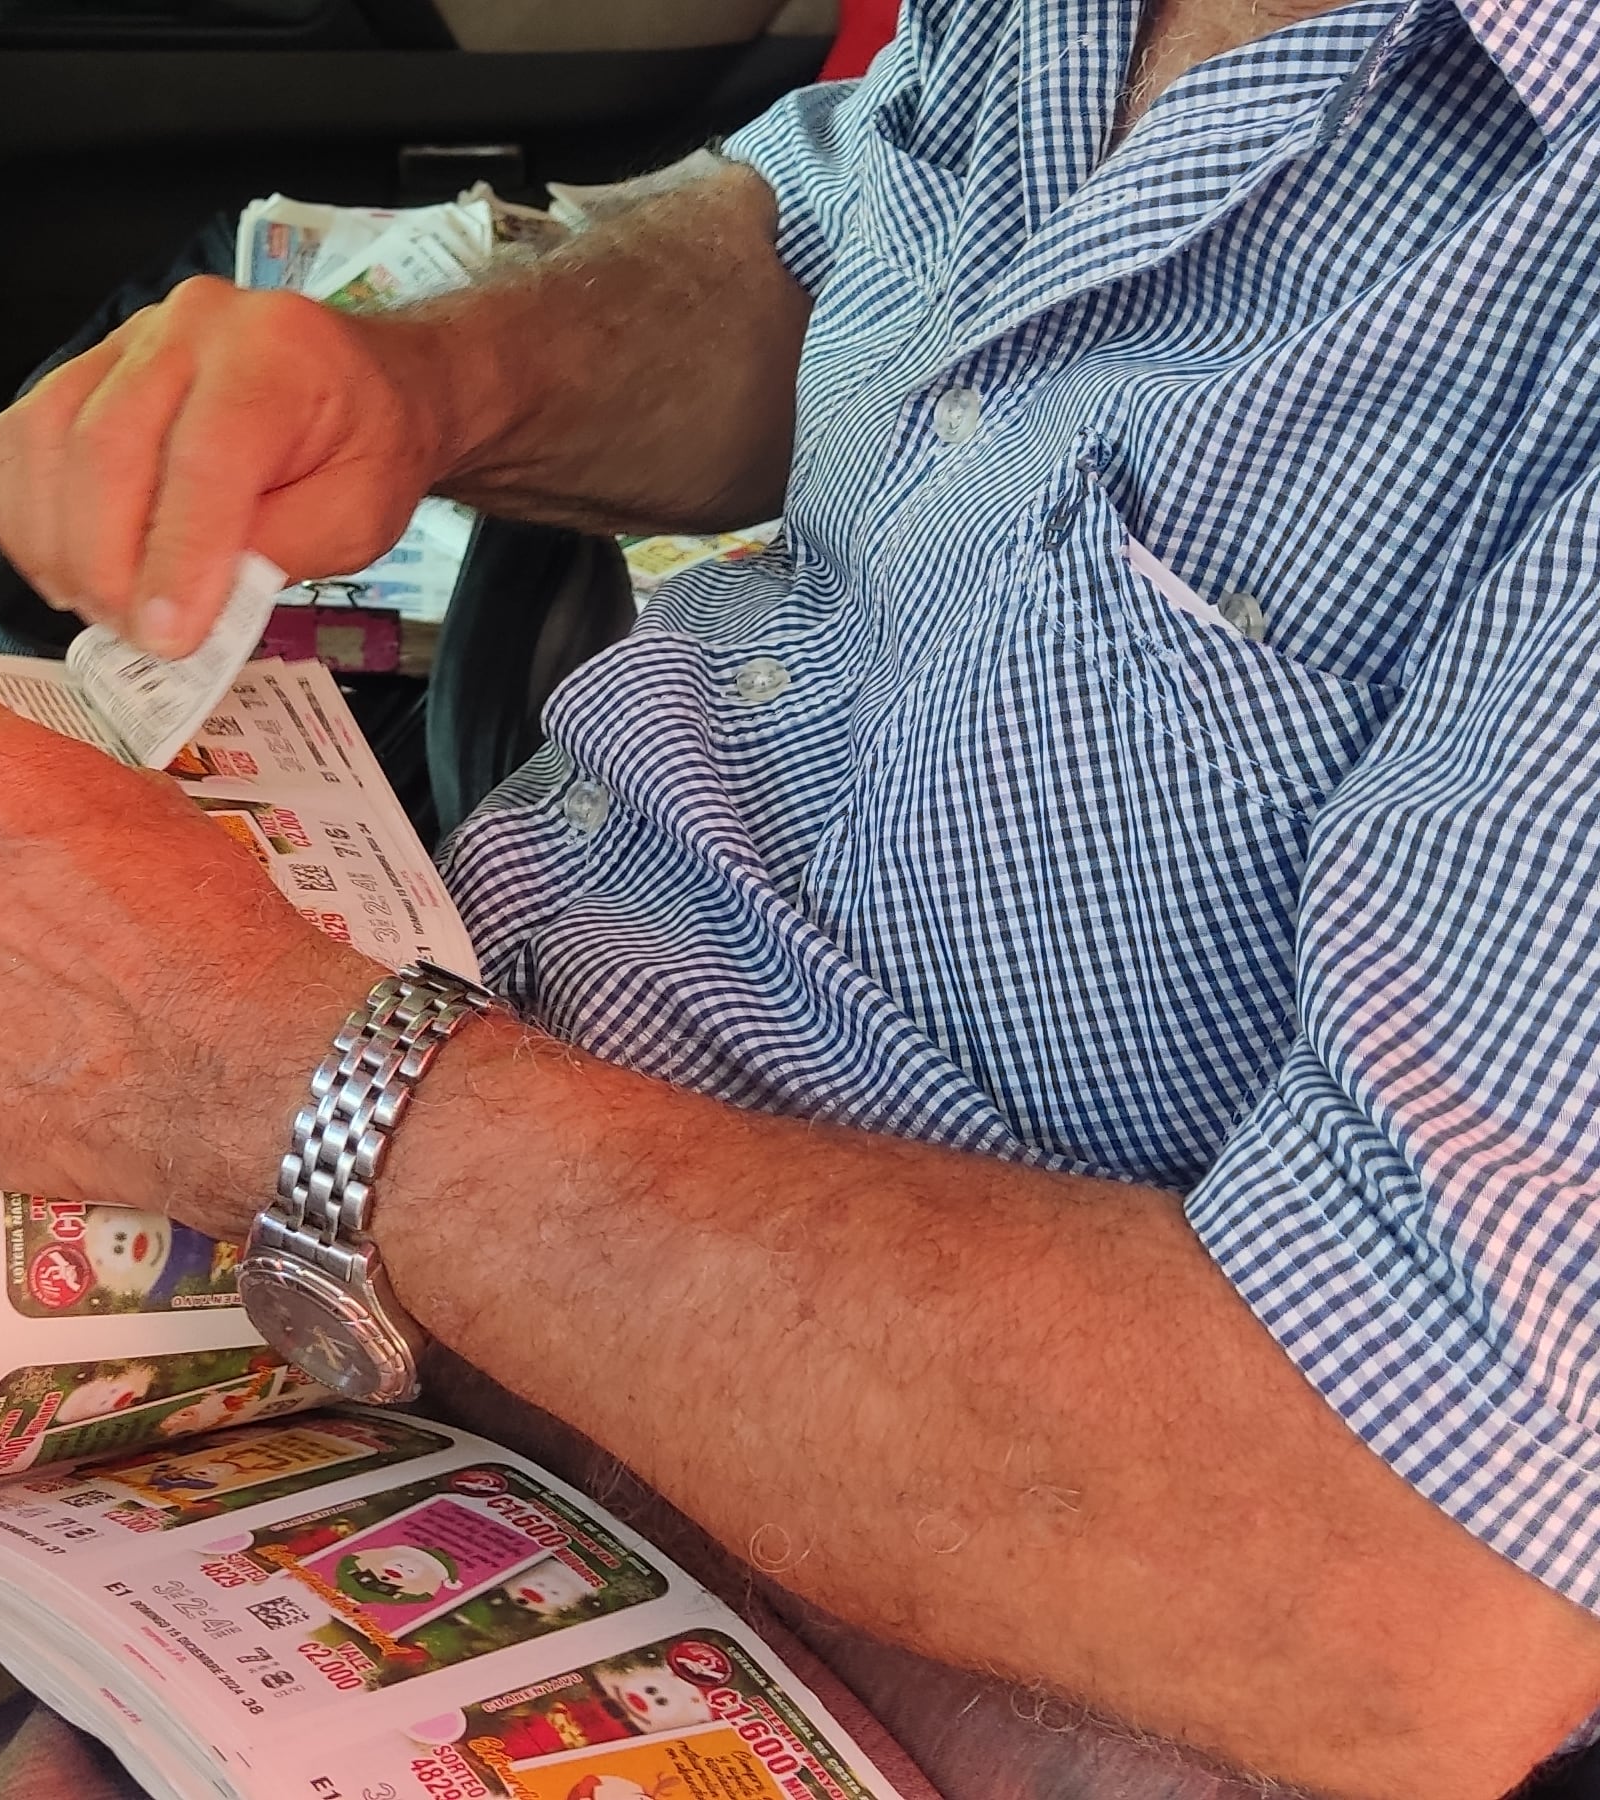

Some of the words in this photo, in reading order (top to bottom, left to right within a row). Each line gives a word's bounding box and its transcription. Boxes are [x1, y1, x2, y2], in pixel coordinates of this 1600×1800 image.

[171, 1293, 243, 1308] RENTAVO
[199, 1560, 248, 1589] 4829
[220, 1550, 271, 1584] SORTEO
[104, 1581, 135, 1598] E1
[241, 1697, 266, 1716] 38
[336, 1641, 378, 1673] VALE
[750, 1695, 805, 1756] PREMIO
[801, 1754, 849, 1800] MAYO
[310, 1775, 343, 1800] E1
[410, 1757, 465, 1800] 4829
[431, 1743, 488, 1800] SORTEO
